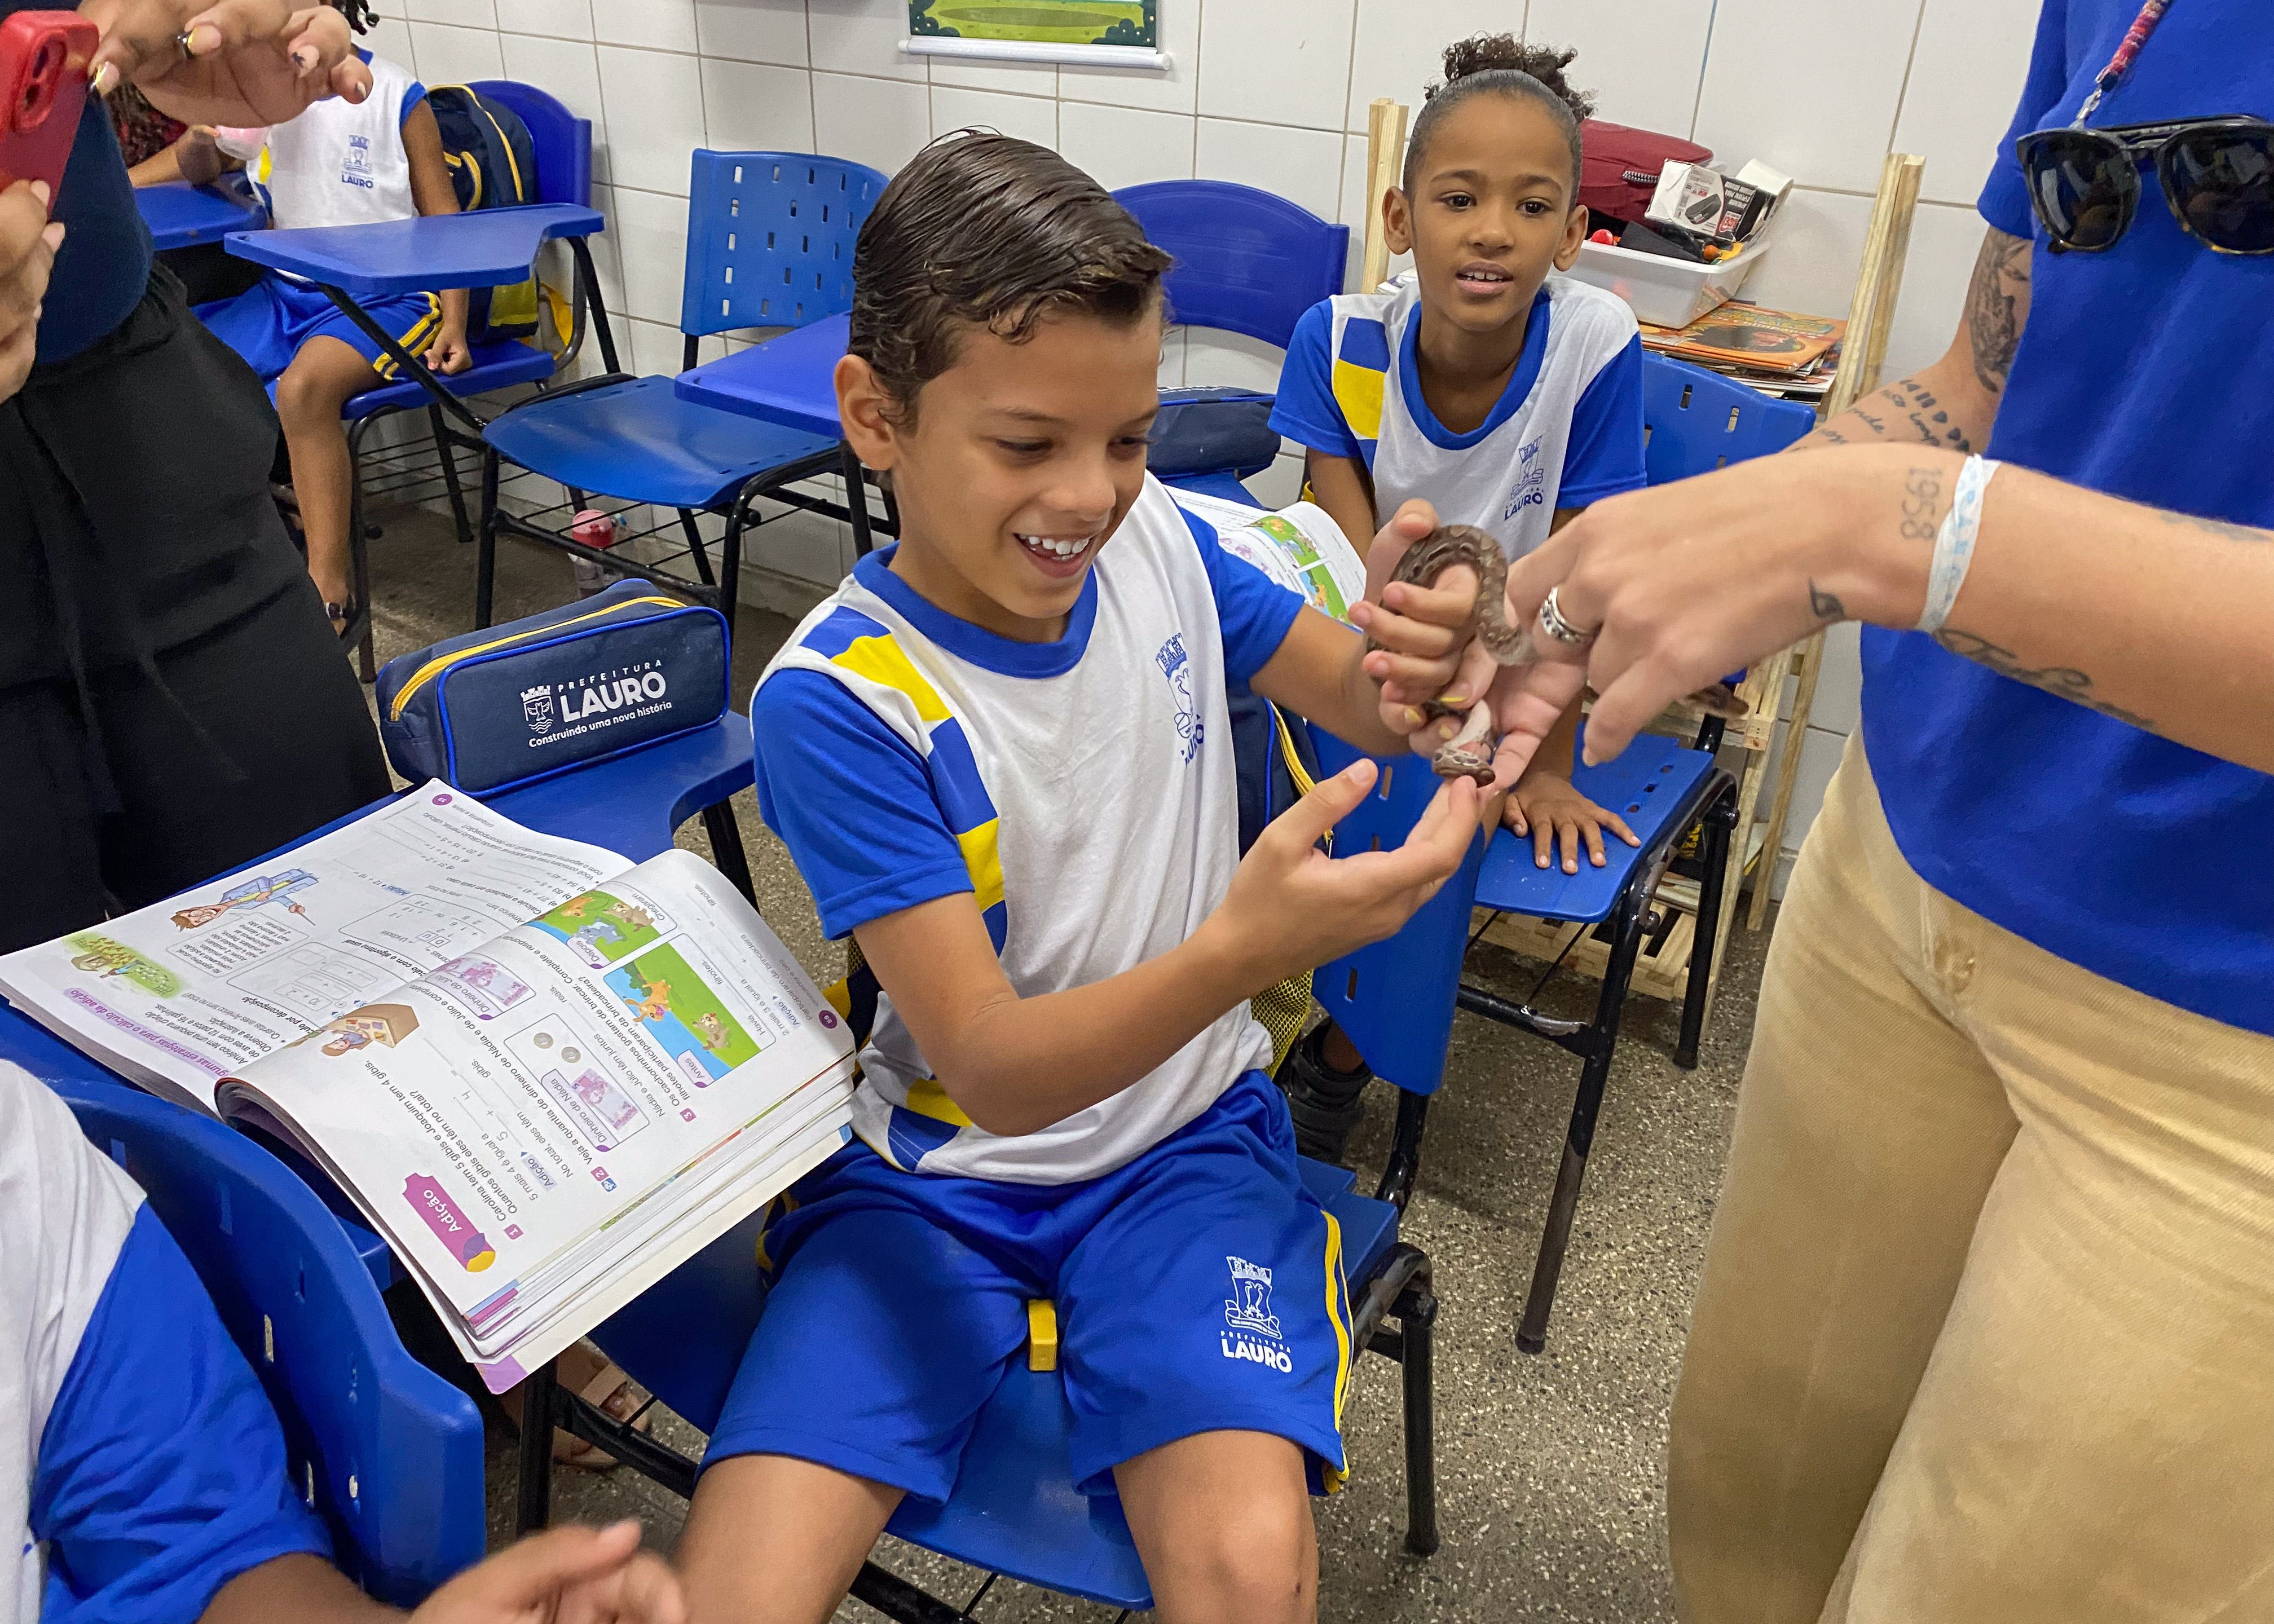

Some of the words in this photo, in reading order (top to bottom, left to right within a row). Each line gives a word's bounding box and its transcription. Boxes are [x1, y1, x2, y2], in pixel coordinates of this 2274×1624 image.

[342, 175, 373, 188] LAURO
[1505, 492, 1543, 520] LAURO
[558, 660, 662, 692] PREFEITURA
[560, 672, 666, 722] LAURO
[529, 725, 587, 747] Construindo
[589, 718, 611, 730] uma
[613, 712, 636, 724] nova
[637, 701, 672, 717] história
[632, 890, 666, 923] Chegaram
[576, 936, 600, 965] Depois
[741, 934, 773, 970] brincadeira
[540, 954, 573, 984] Complete
[702, 961, 724, 985] filhotes.
[770, 969, 780, 979] da
[70, 990, 98, 1007] adição
[462, 988, 490, 1013] Dinheiro
[549, 985, 567, 1003] reais.
[572, 983, 597, 1010] brincar.
[578, 977, 620, 1018] brincadeira?
[744, 985, 761, 1001] igual
[779, 979, 815, 1021] Participaram
[285, 1016, 303, 1027] por
[447, 1005, 466, 1020] Júlio
[596, 1009, 607, 1020] de
[618, 1017, 629, 1027] da
[769, 1012, 785, 1030] mais
[778, 1001, 800, 1025] Adição
[298, 1023, 315, 1036] culo
[464, 1020, 475, 1030] de
[605, 1020, 632, 1046] gostam
[748, 1014, 766, 1035] Havia
[139, 1030, 161, 1044] para
[480, 1035, 502, 1058] Nádia
[593, 1034, 617, 1056] juntos
[628, 1027, 669, 1072] participaram
[365, 1060, 386, 1079] gibis.
[471, 1059, 491, 1078] gibis.
[500, 1057, 512, 1068] de
[613, 1055, 627, 1071] têm
[629, 1047, 671, 1093] cachorrinhos
[685, 1058, 705, 1079] Antes
[510, 1069, 539, 1098] dinheiro
[626, 1070, 642, 1087] Júlio
[666, 1072, 690, 1100] filhotes
[389, 1085, 406, 1102] tem
[550, 1078, 572, 1102] Nádia
[669, 1094, 680, 1106] Os
[409, 1091, 433, 1112] total?
[537, 1098, 548, 1110] de
[570, 1101, 581, 1111] de
[646, 1093, 666, 1117] Nádia
[404, 1101, 436, 1133] Joaquim
[431, 1112, 444, 1123] no
[517, 1111, 532, 1128] têm
[547, 1109, 573, 1138] quantia
[579, 1111, 607, 1143] Dinheiro
[442, 1123, 457, 1140] têm
[530, 1127, 546, 1144] eles
[439, 1141, 461, 1162] gibis
[455, 1140, 472, 1157] eles
[485, 1140, 505, 1159] igual
[544, 1143, 562, 1165] total,
[577, 1145, 592, 1165] Veja
[462, 1168, 479, 1187] tem
[470, 1157, 491, 1178] gibis
[528, 1158, 554, 1186] Adição
[561, 1164, 574, 1178] No
[596, 1170, 605, 1178] 2
[514, 1173, 533, 1193] mais
[477, 1186, 506, 1221] Carolina
[487, 1178, 517, 1214] Quantos
[424, 1190, 462, 1232] Adição
[1222, 1339, 1292, 1373] LAURO
